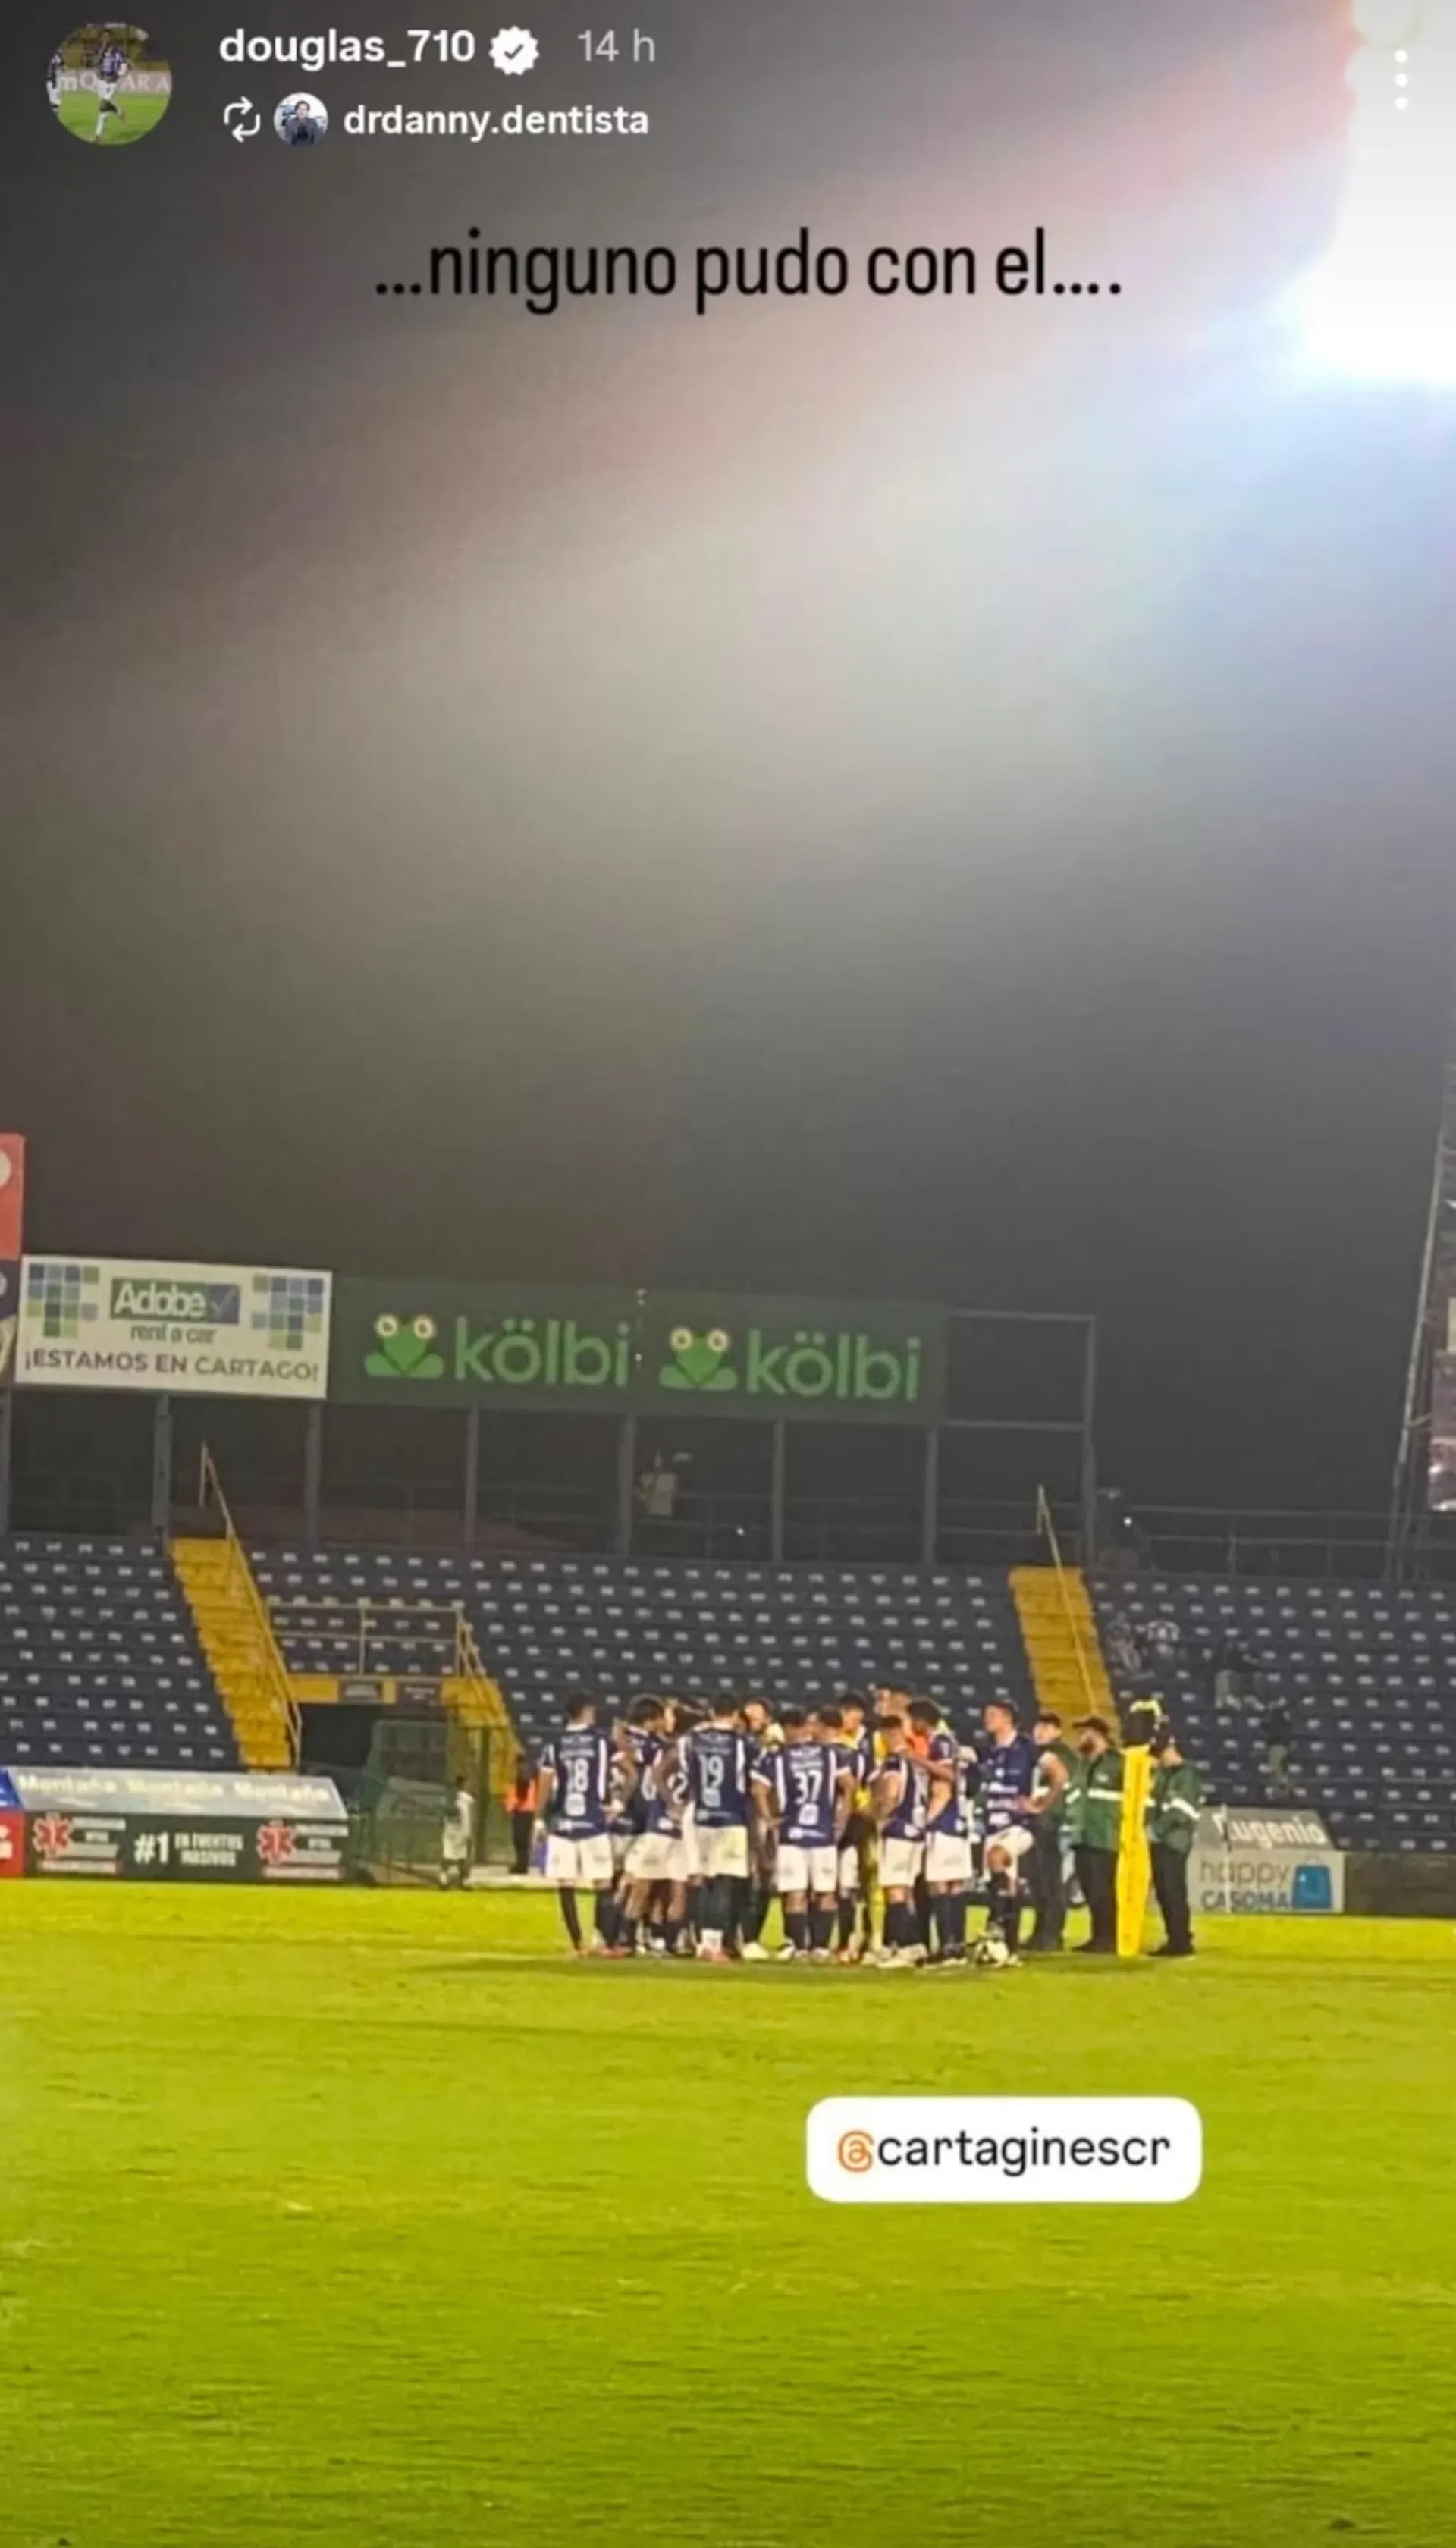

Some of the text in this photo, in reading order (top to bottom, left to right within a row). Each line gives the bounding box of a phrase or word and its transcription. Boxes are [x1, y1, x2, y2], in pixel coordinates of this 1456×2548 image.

[115, 1282, 206, 1318] Adobe
[130, 1323, 217, 1345] rent a car
[24, 1348, 320, 1382] ¡ESTAMOS EN CARTAGO!
[455, 1316, 629, 1388] kölbi
[747, 1329, 922, 1401] kölbi
[563, 1758, 589, 1791] 18
[698, 1753, 725, 1790] 19
[792, 1768, 822, 1805] 37
[133, 1831, 169, 1865] #1
[1199, 1860, 1290, 1891] happy
